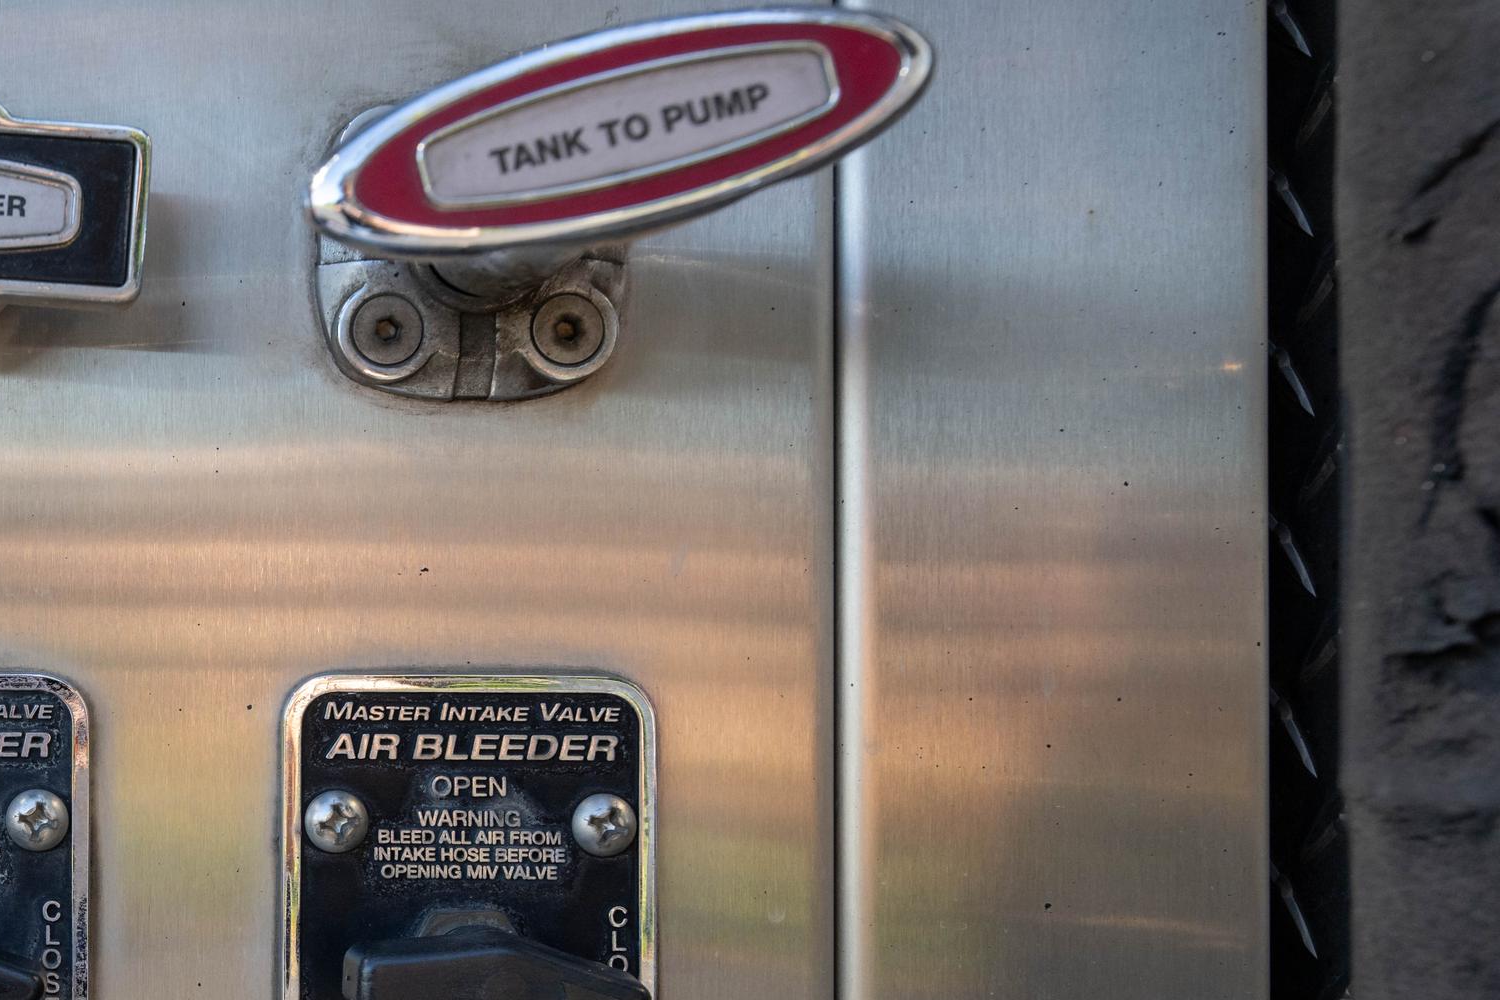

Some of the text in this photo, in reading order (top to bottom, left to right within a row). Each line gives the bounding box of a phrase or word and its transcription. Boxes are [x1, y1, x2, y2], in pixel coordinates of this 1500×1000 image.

[489, 82, 770, 174] TANK TO PUMP
[326, 734, 619, 761] AIR BLEEDER
[431, 775, 507, 798] OPEN
[418, 810, 521, 828] WARNING
[378, 829, 561, 845] BLEED ALL AIR FROM
[374, 847, 565, 863] INTAKE HOSE BEFORE
[380, 864, 558, 880] OPENING MIV VALVE
[608, 905, 628, 973] CLO
